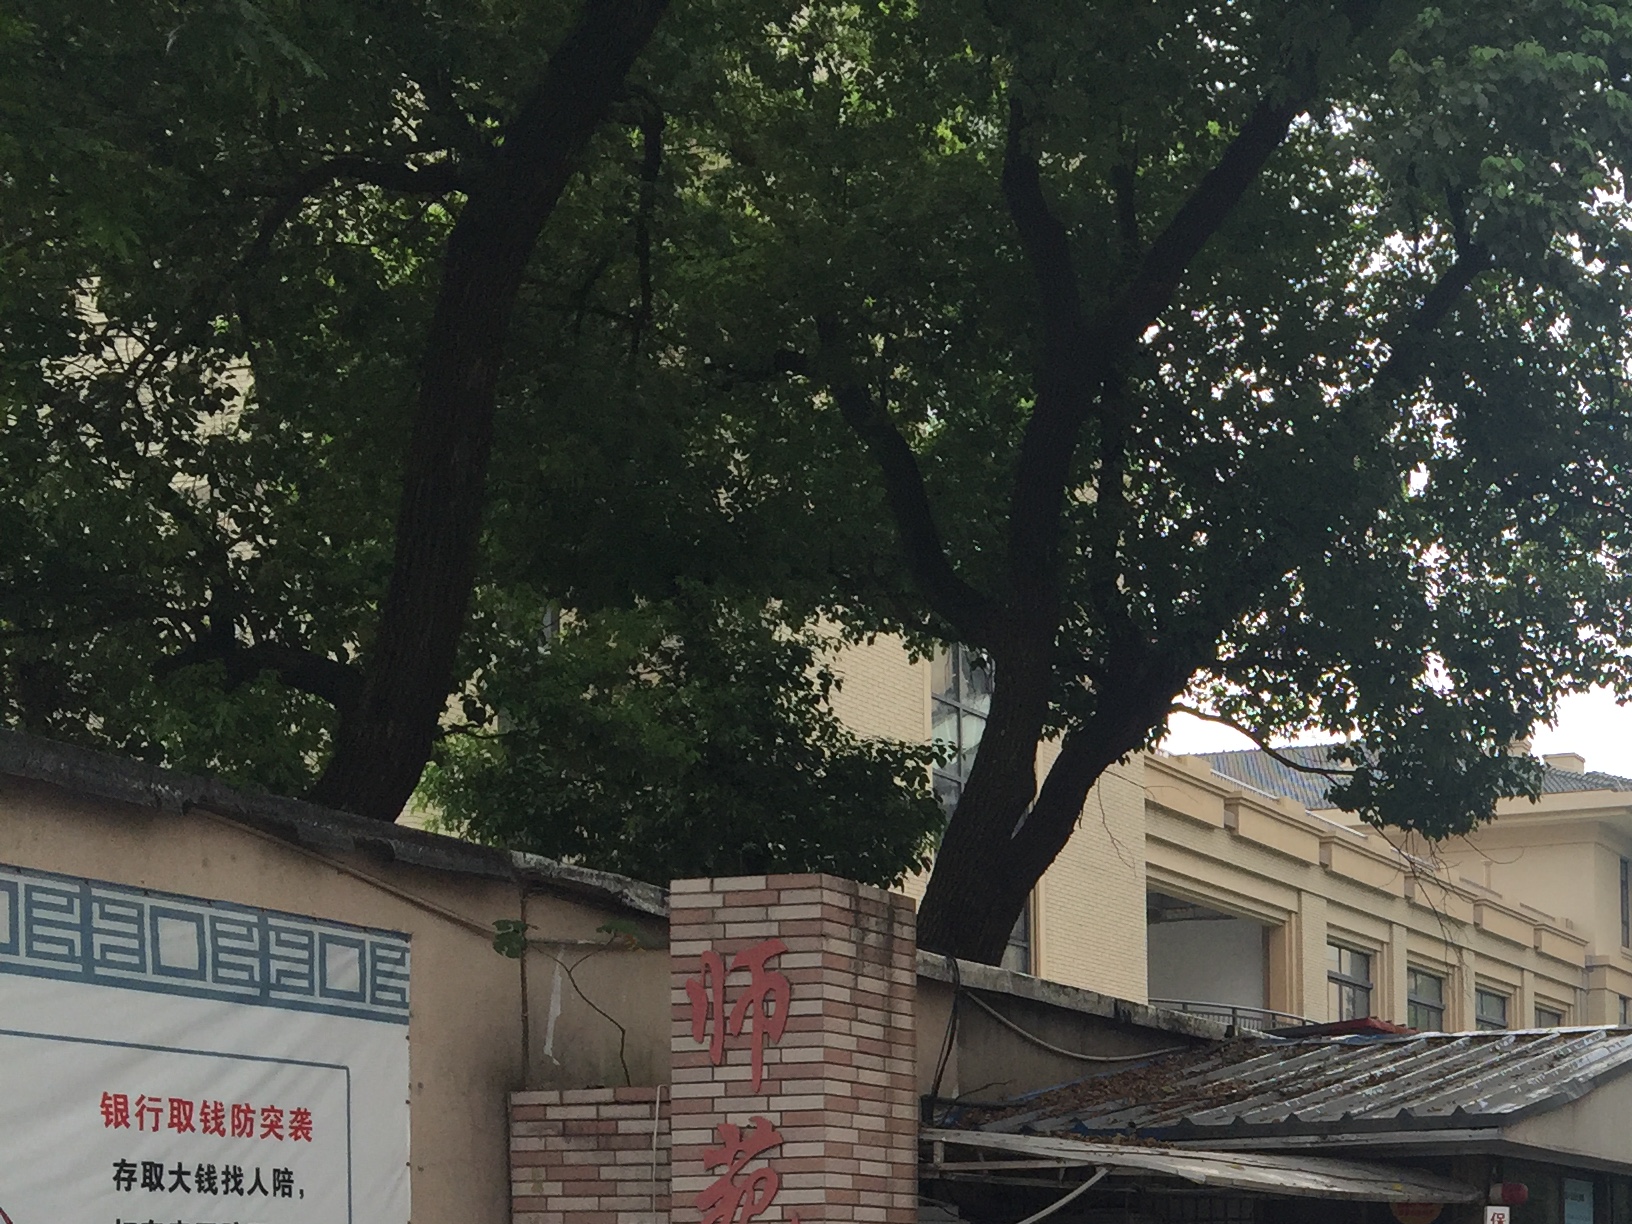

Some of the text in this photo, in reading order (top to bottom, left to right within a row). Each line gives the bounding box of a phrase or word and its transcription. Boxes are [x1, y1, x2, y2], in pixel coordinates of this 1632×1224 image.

[100, 1091, 314, 1142] 银行取钱防突袭
[112, 1158, 305, 1199] 存取大钱找人陪，
